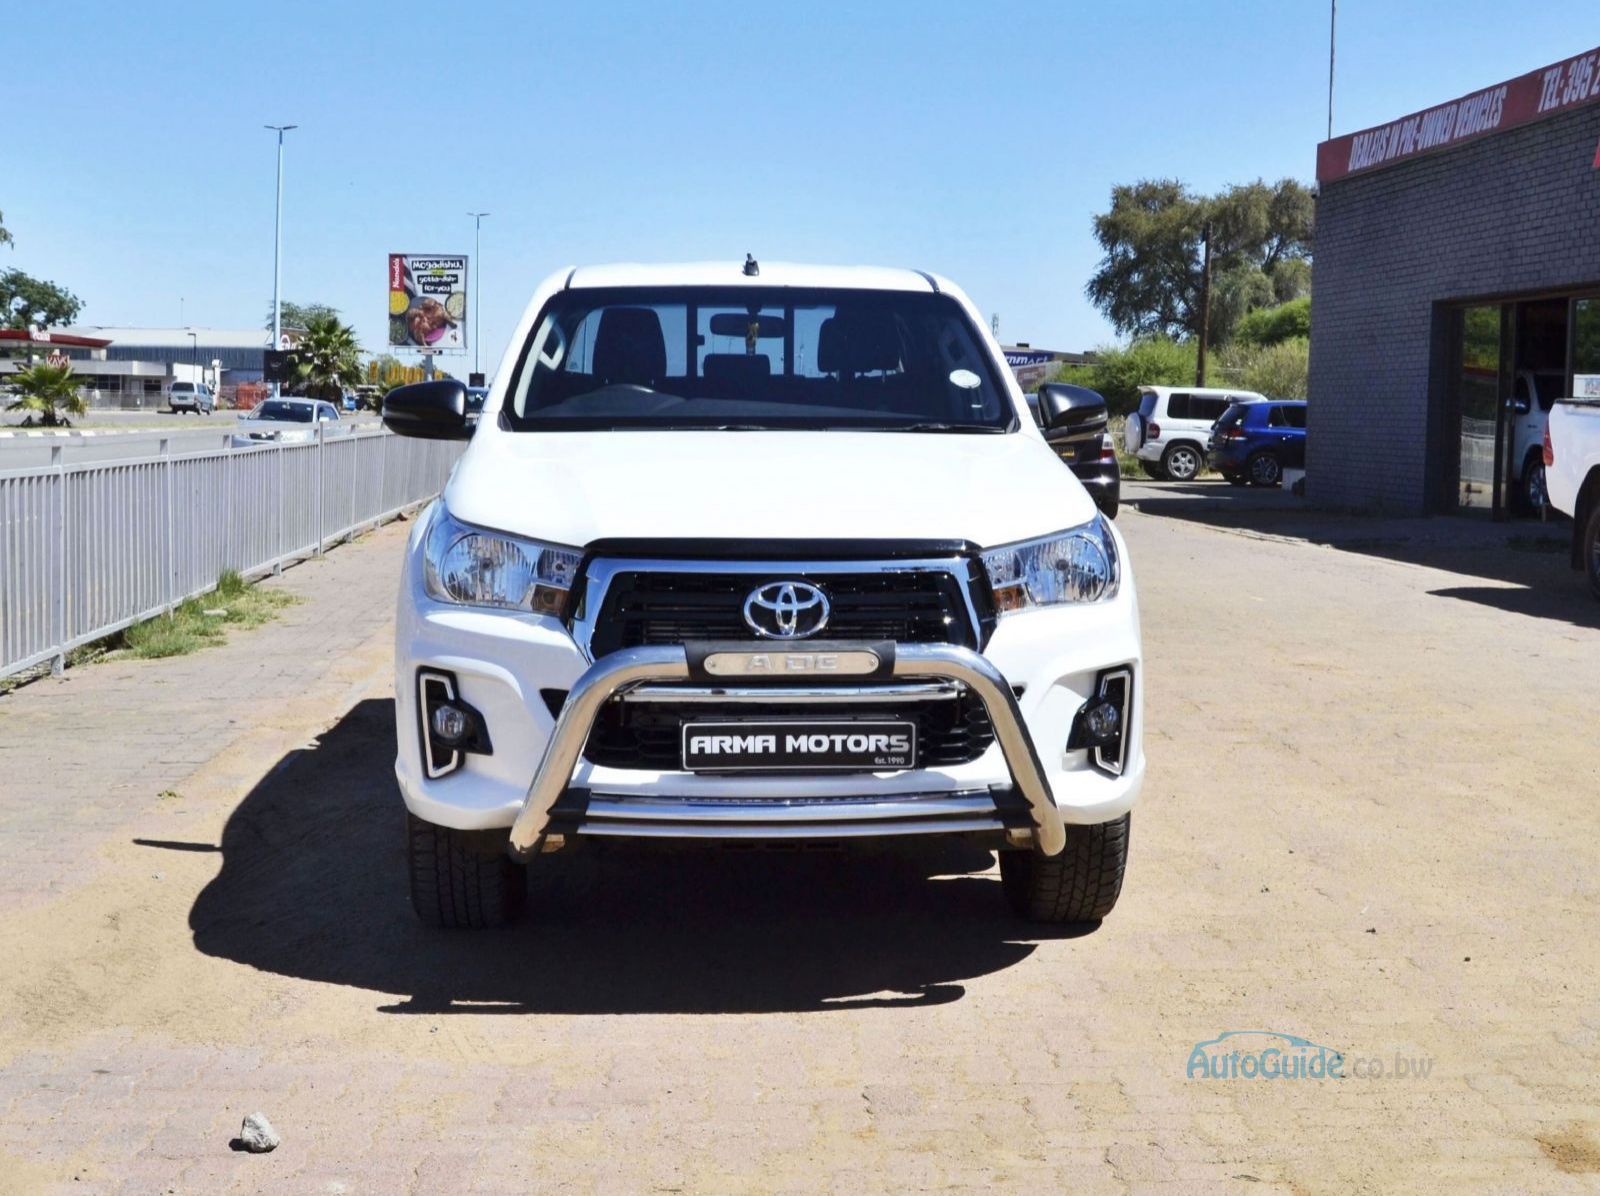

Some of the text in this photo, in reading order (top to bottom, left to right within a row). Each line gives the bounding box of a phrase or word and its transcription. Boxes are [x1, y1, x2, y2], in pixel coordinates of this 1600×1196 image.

[1348, 126, 1391, 172] DEALERS
[1385, 122, 1403, 160] IN
[1397, 104, 1458, 157] PRE-OWNED
[1453, 85, 1508, 139] VEHICLES
[690, 735, 911, 754] ARMA MOTORS
[888, 756, 905, 765] 1990
